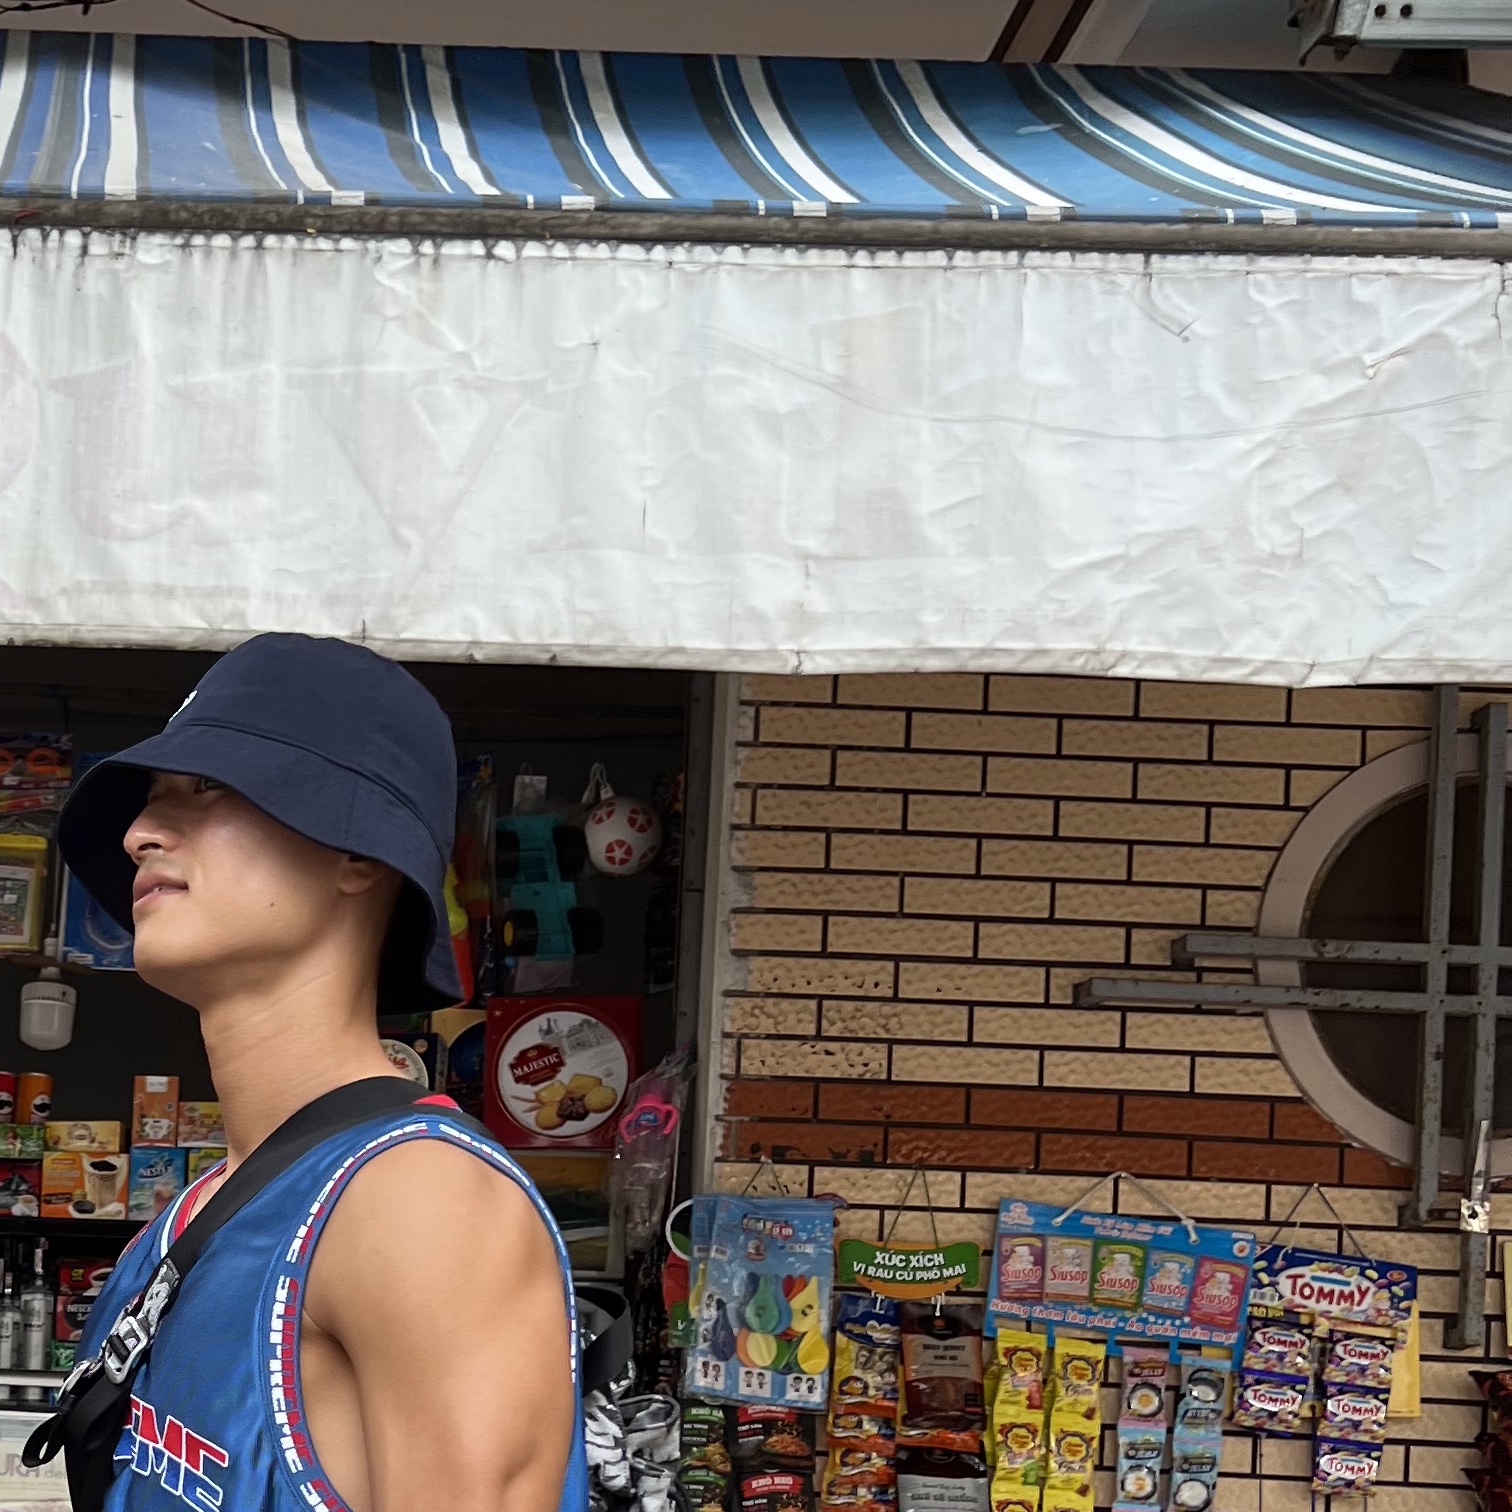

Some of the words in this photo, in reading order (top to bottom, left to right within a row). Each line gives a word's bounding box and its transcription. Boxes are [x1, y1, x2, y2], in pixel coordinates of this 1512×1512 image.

[512, 1050, 560, 1079] MAJESTIC
[874, 1250, 906, 1268] XÚC
[908, 1251, 945, 1268] XÍCH
[852, 1261, 865, 1277] VỊ
[866, 1265, 893, 1280] RAU
[895, 1267, 915, 1281] CỦ
[915, 1267, 941, 1281] PHÔ
[942, 1263, 967, 1278] MAI
[1098, 1272, 1139, 1291] Siusop
[1148, 1278, 1188, 1297] Siusop
[1286, 1273, 1371, 1308] TOMMY
[1260, 1330, 1307, 1349] TOMMY
[1340, 1343, 1389, 1362] TOMMY
[1250, 1388, 1298, 1408] TOMMY
[1337, 1399, 1383, 1417] TOMMY
[1327, 1457, 1374, 1476] TOMMY
